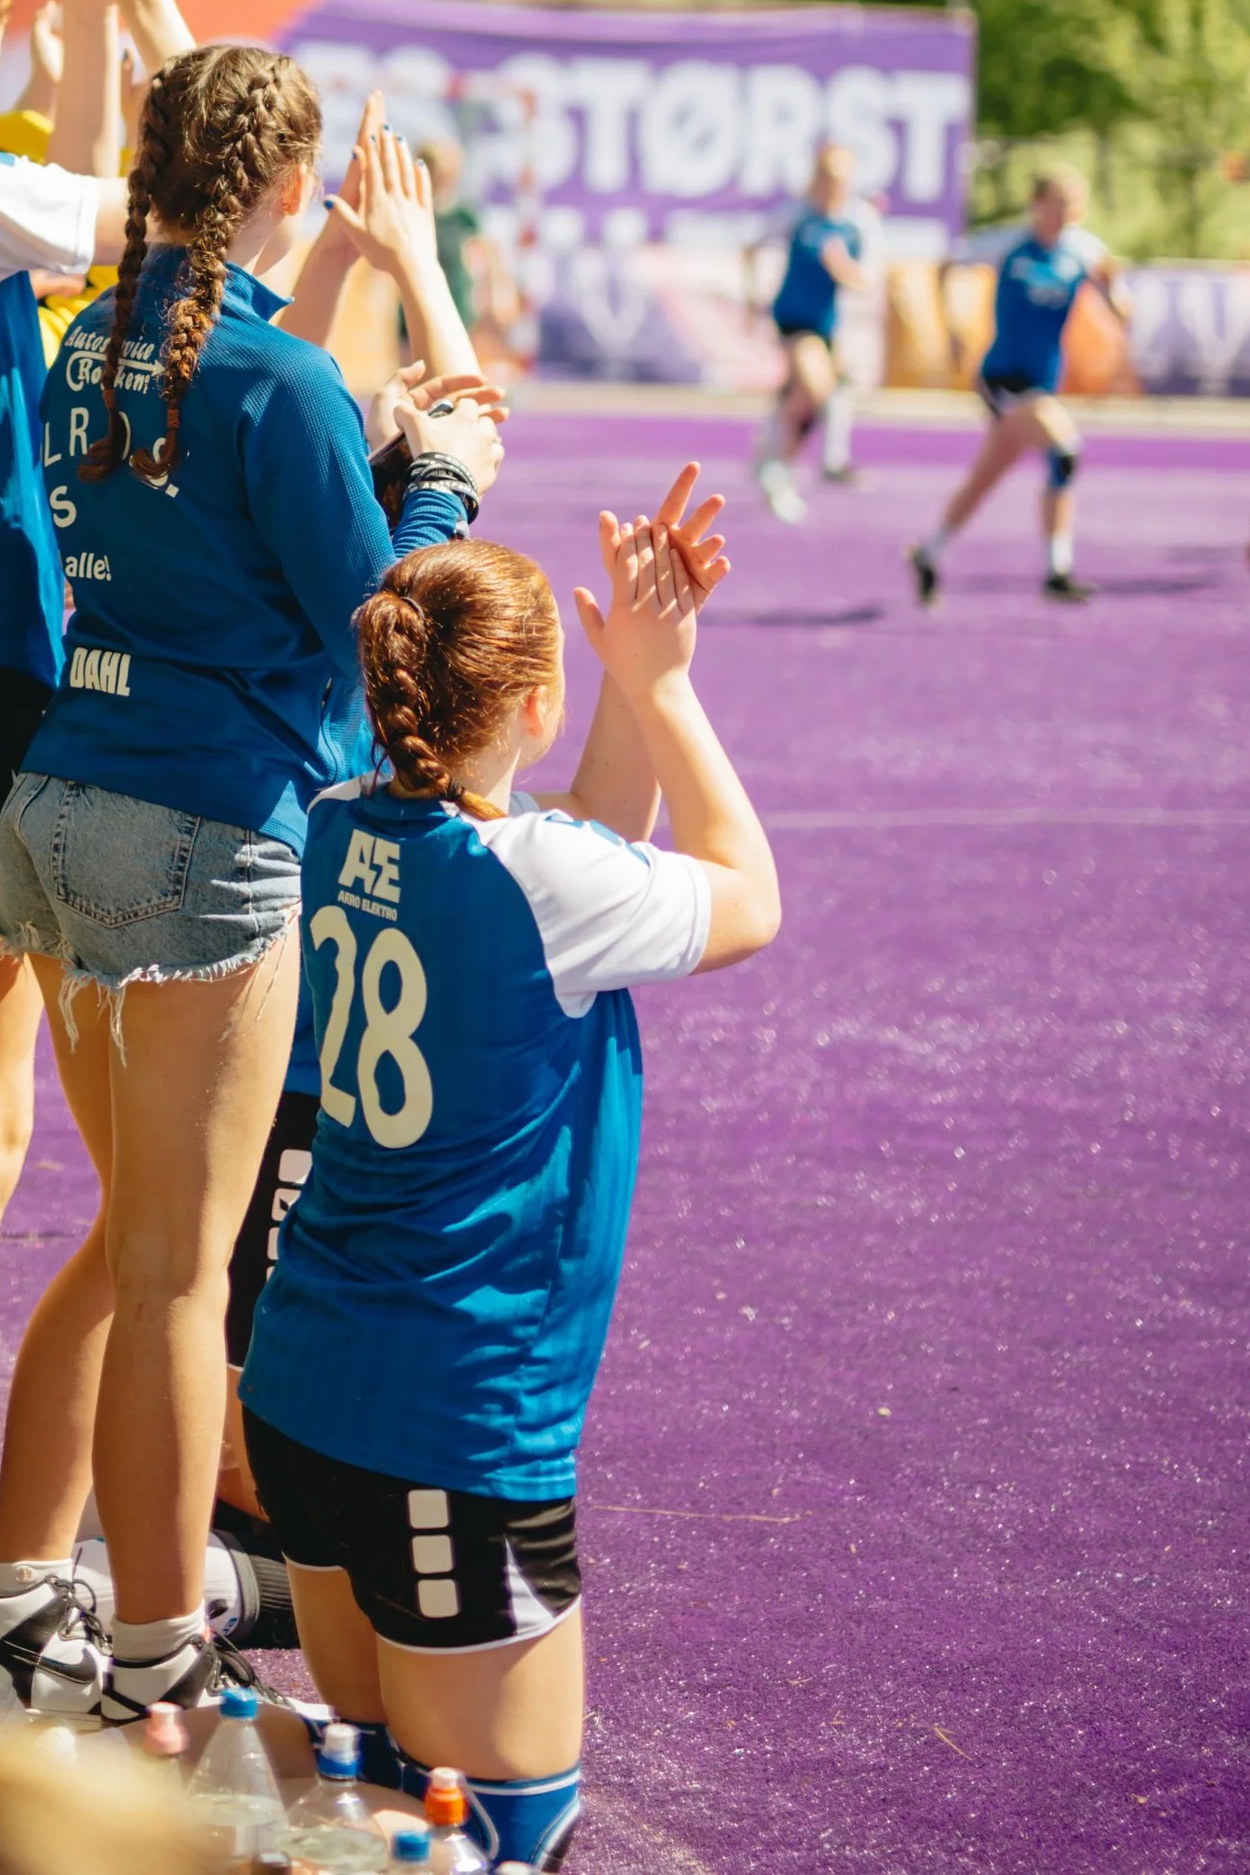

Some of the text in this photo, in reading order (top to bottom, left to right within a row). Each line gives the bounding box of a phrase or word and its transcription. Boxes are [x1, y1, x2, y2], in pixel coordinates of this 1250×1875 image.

[64, 325, 155, 361] Autosvice
[64, 552, 112, 582] alle!
[69, 646, 131, 697] DAHL
[361, 897, 399, 922] ELEKTRO
[309, 904, 434, 1150] 28
